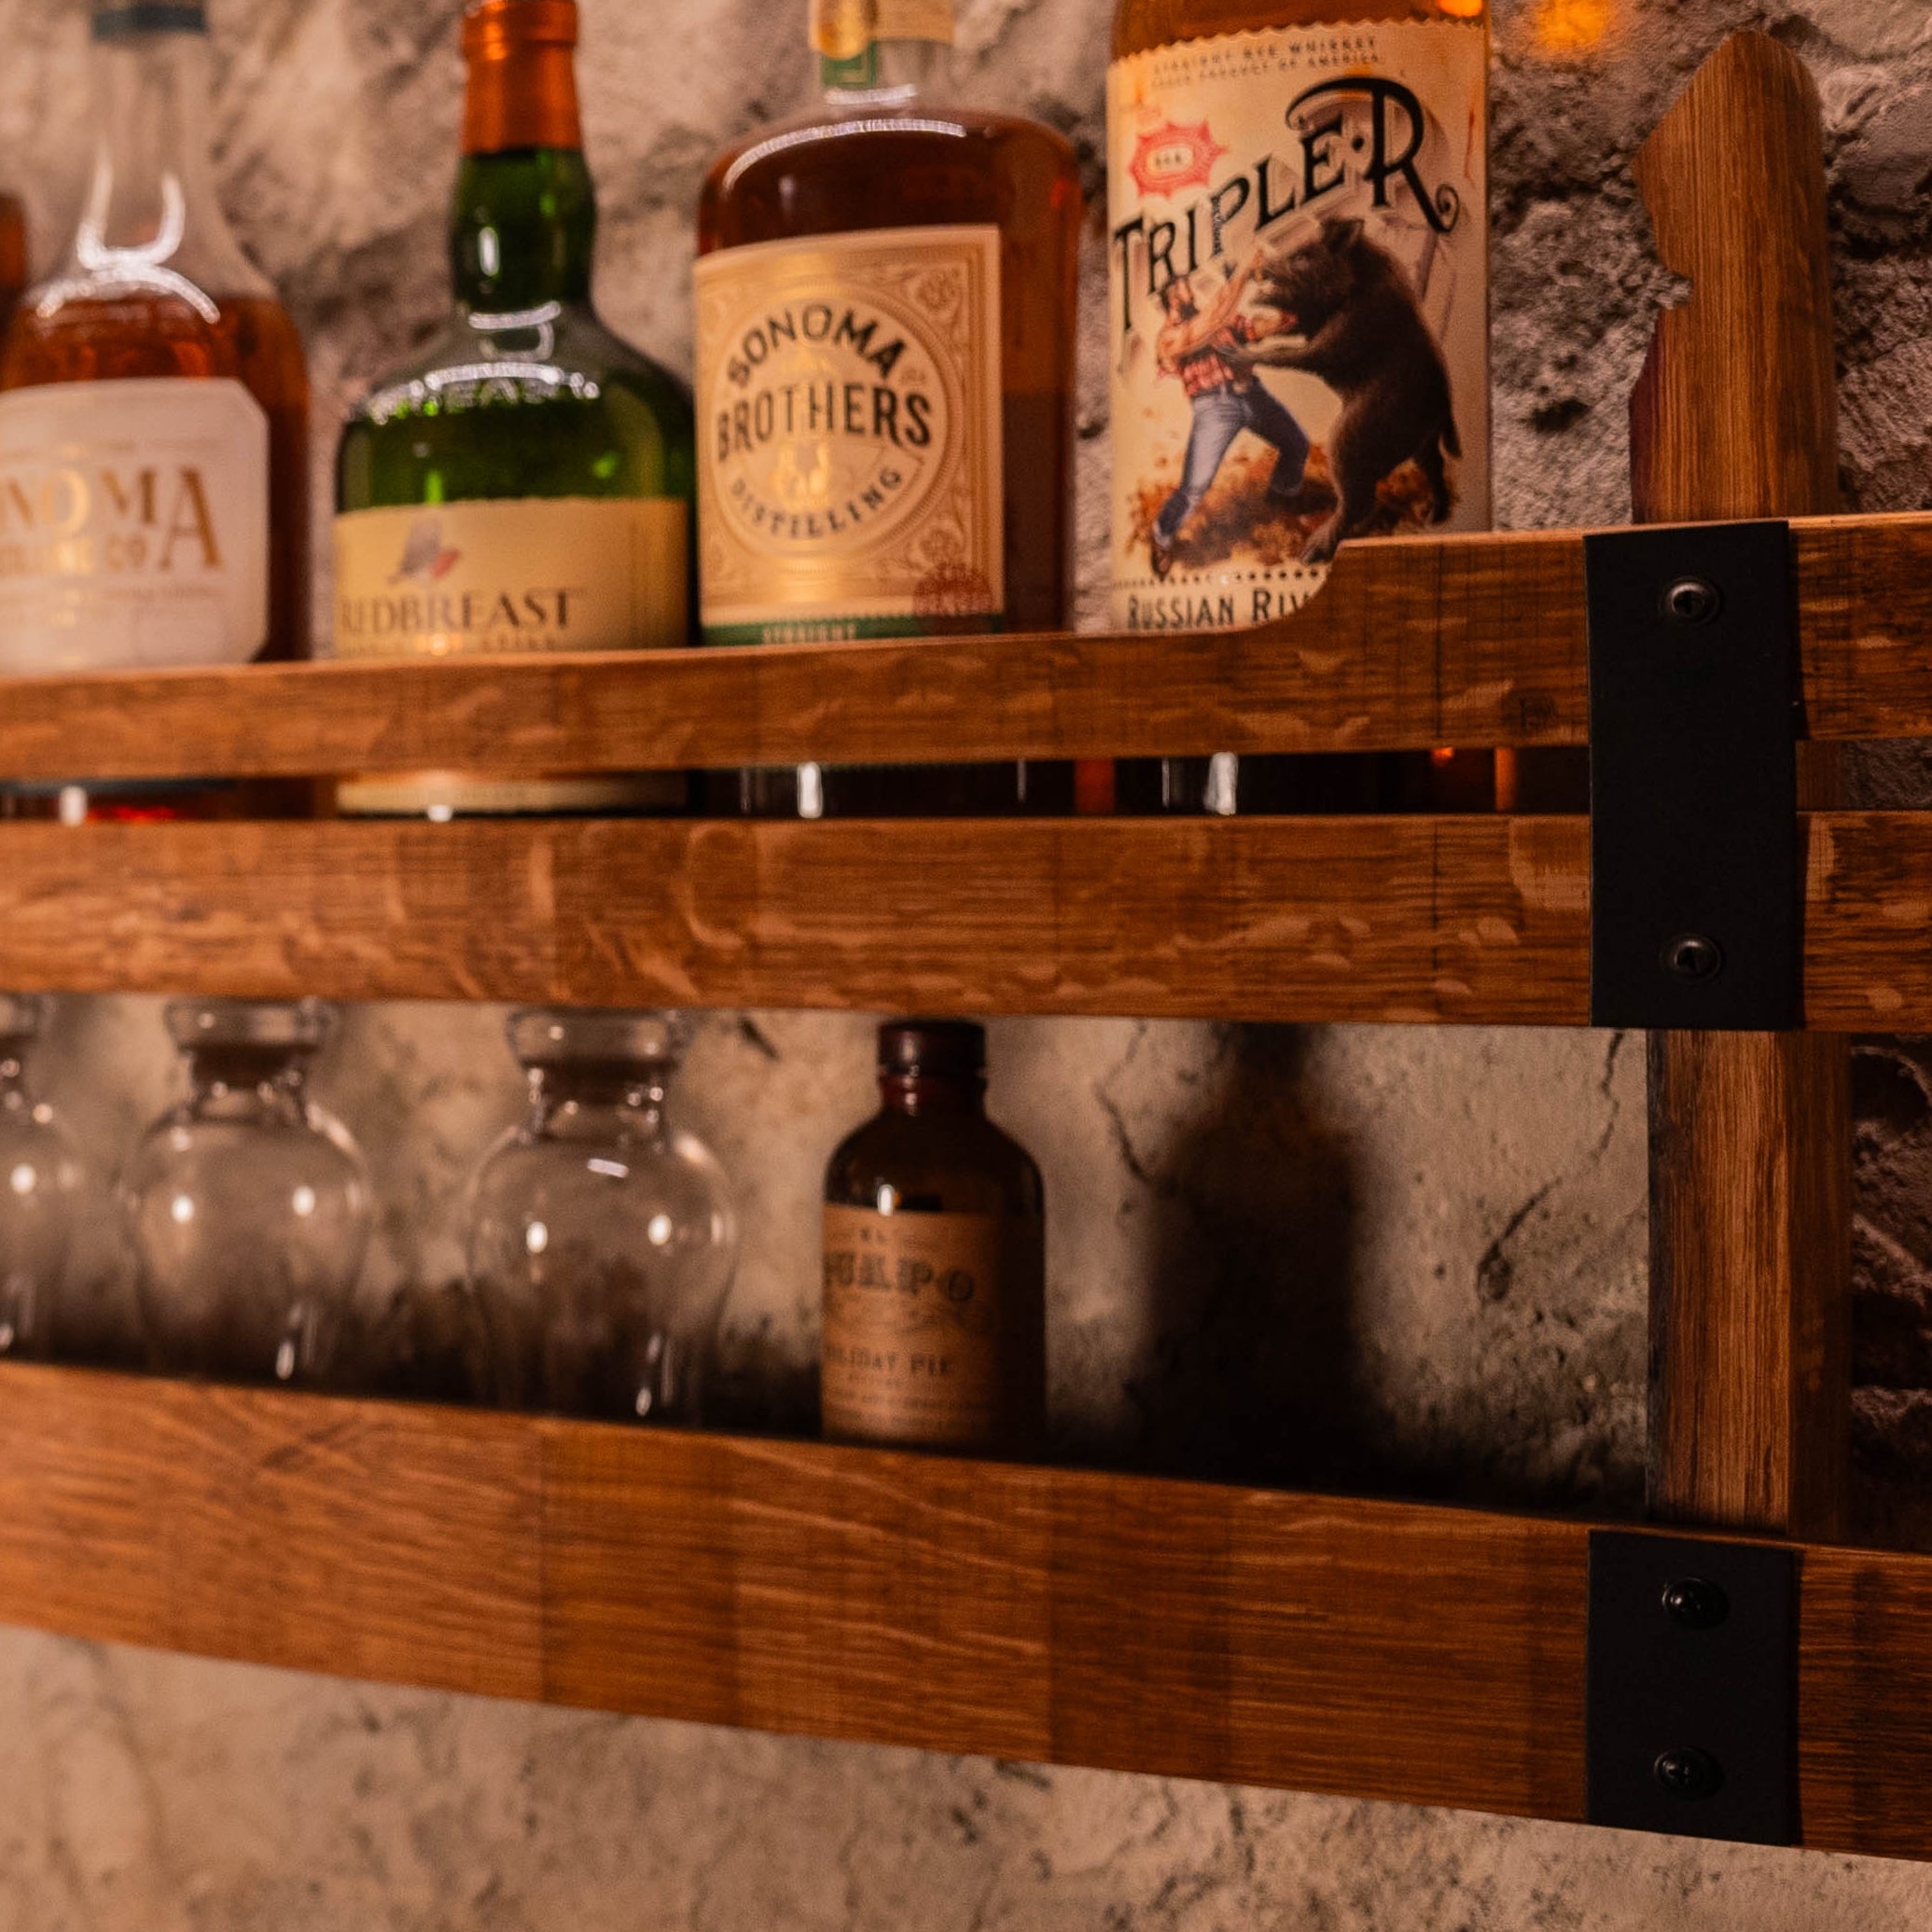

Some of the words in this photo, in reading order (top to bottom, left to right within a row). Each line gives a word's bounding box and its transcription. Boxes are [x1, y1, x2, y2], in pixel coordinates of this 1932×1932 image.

[728, 302, 907, 390] SONOMA
[716, 381, 932, 463] BROTHERS
[730, 466, 902, 540] DISTILLING
[340, 587, 585, 632] REDBREAST
[1127, 594, 1234, 631] RUSSIAN
